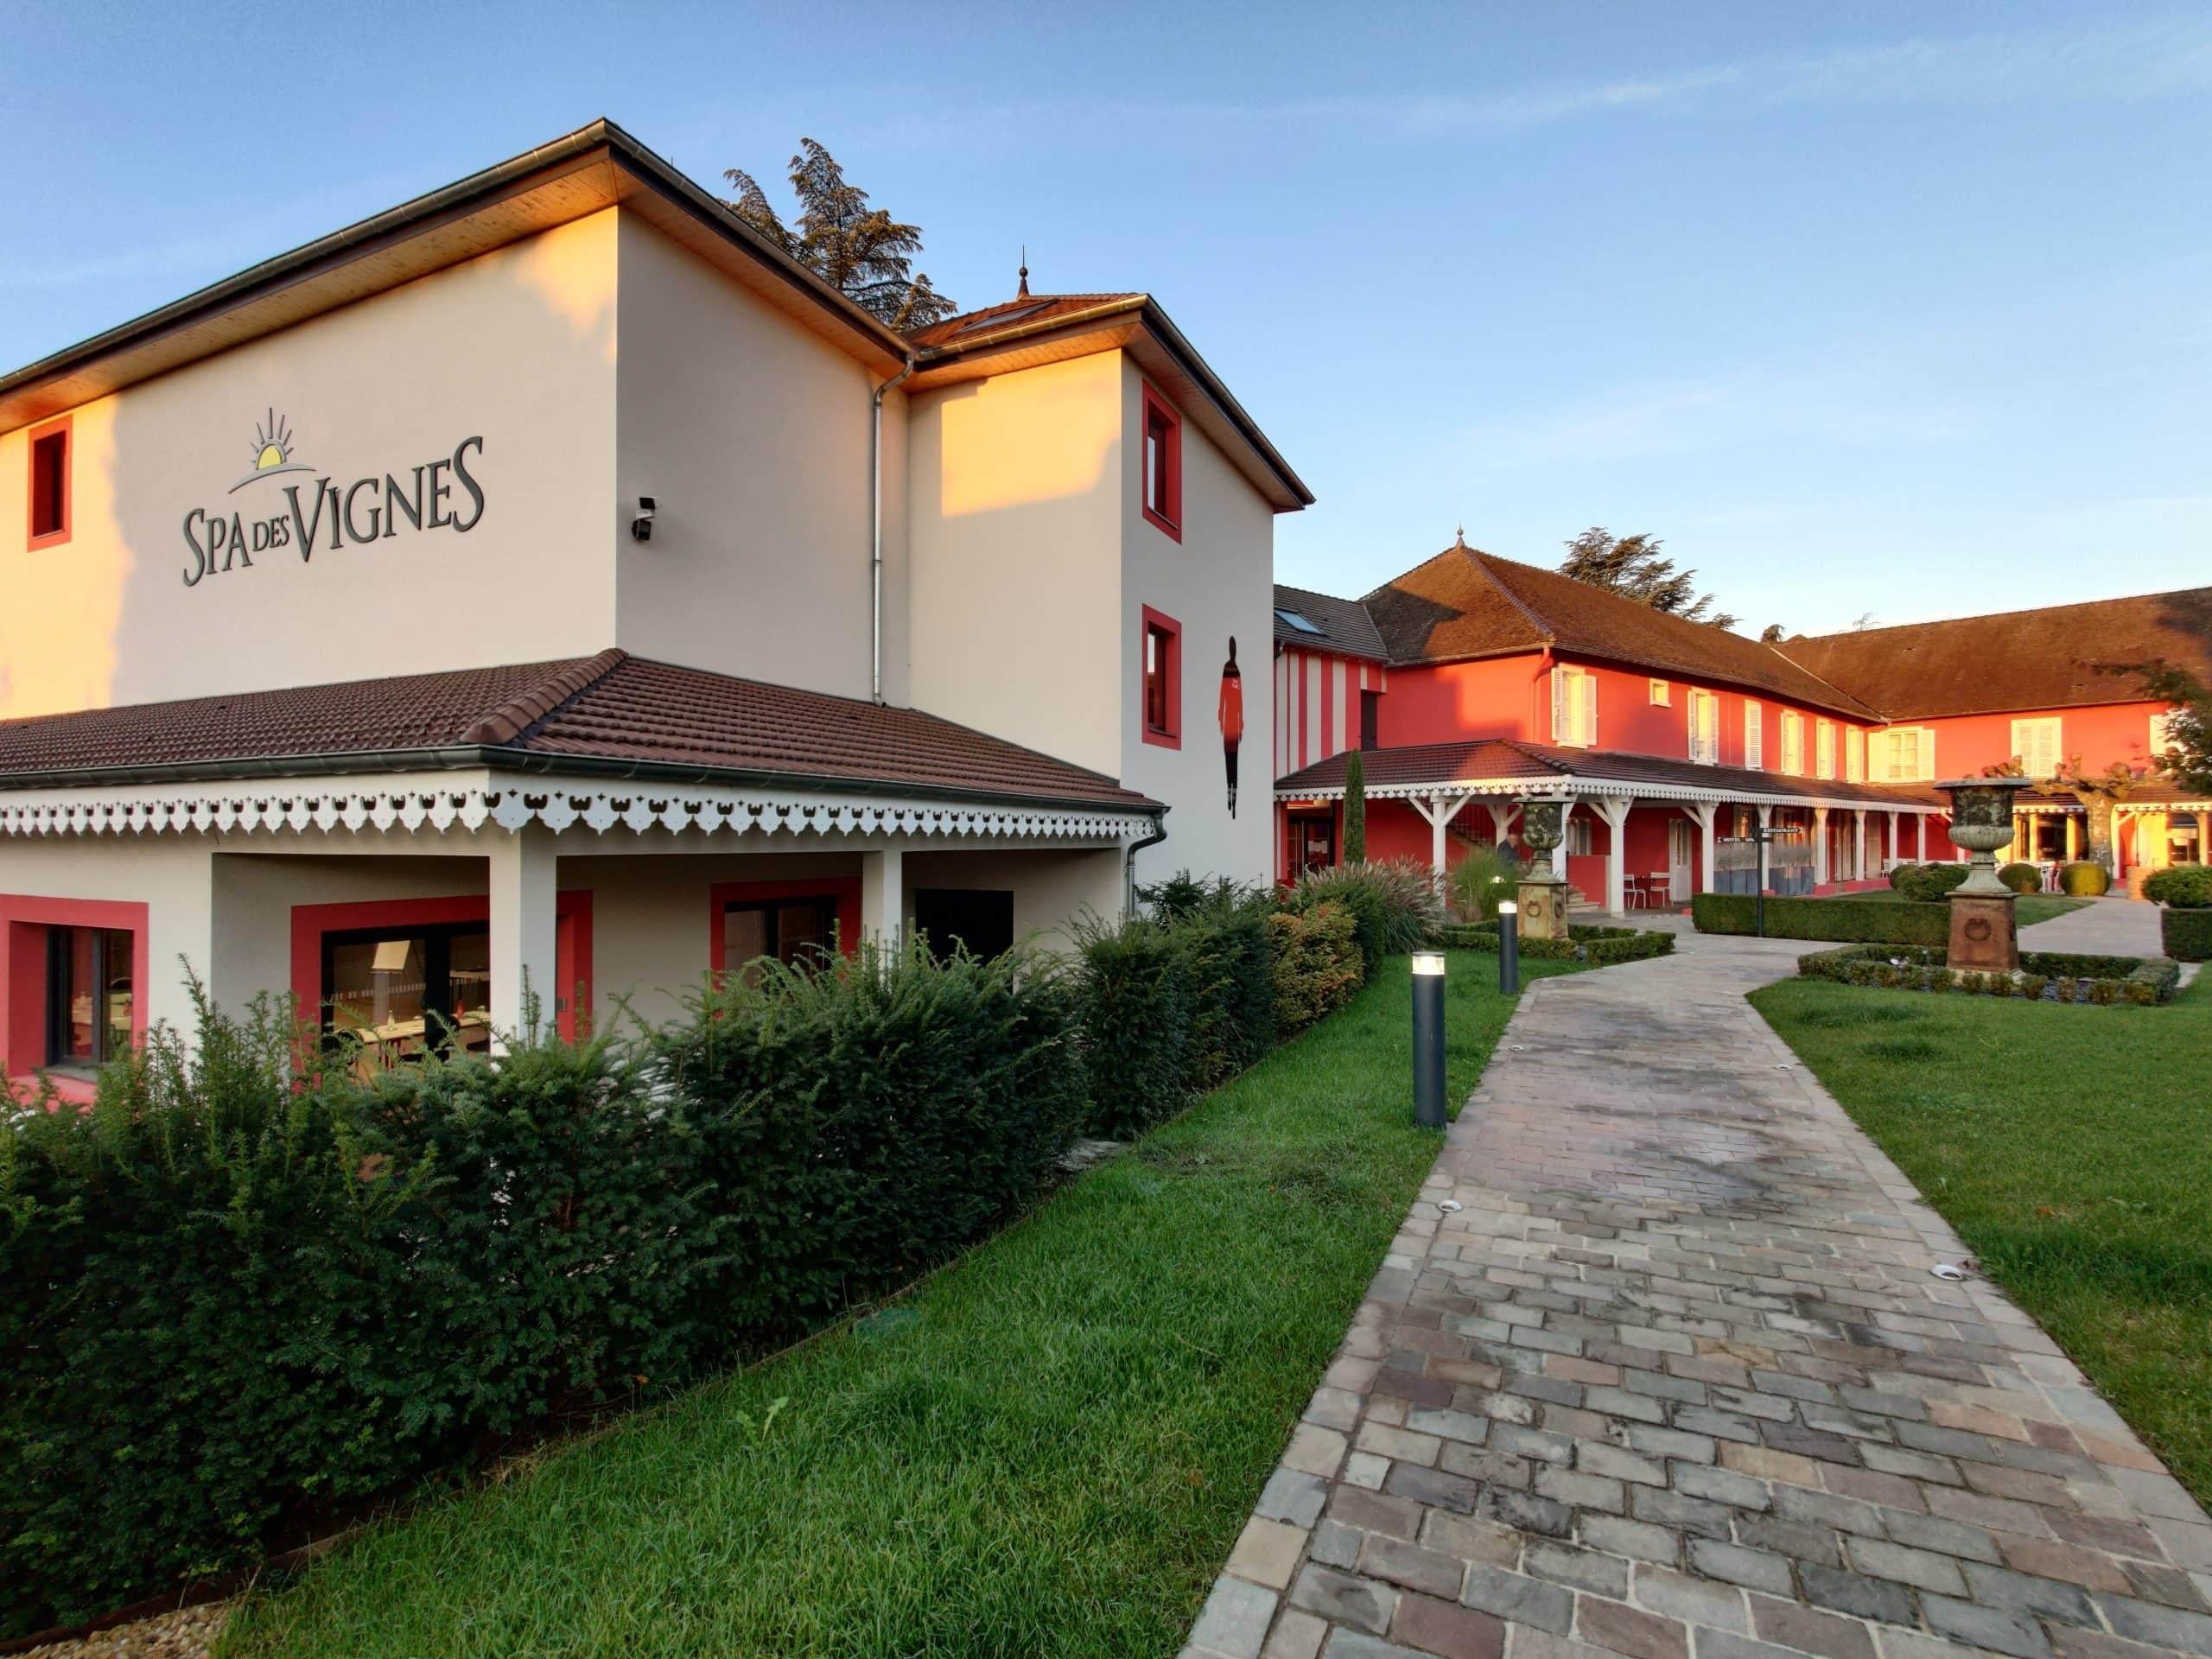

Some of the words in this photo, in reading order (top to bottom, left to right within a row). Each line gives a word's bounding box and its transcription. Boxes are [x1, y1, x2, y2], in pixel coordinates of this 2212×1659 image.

[182, 507, 253, 587] SPA
[252, 514, 289, 552] DES
[282, 435, 485, 563] VIGNES
